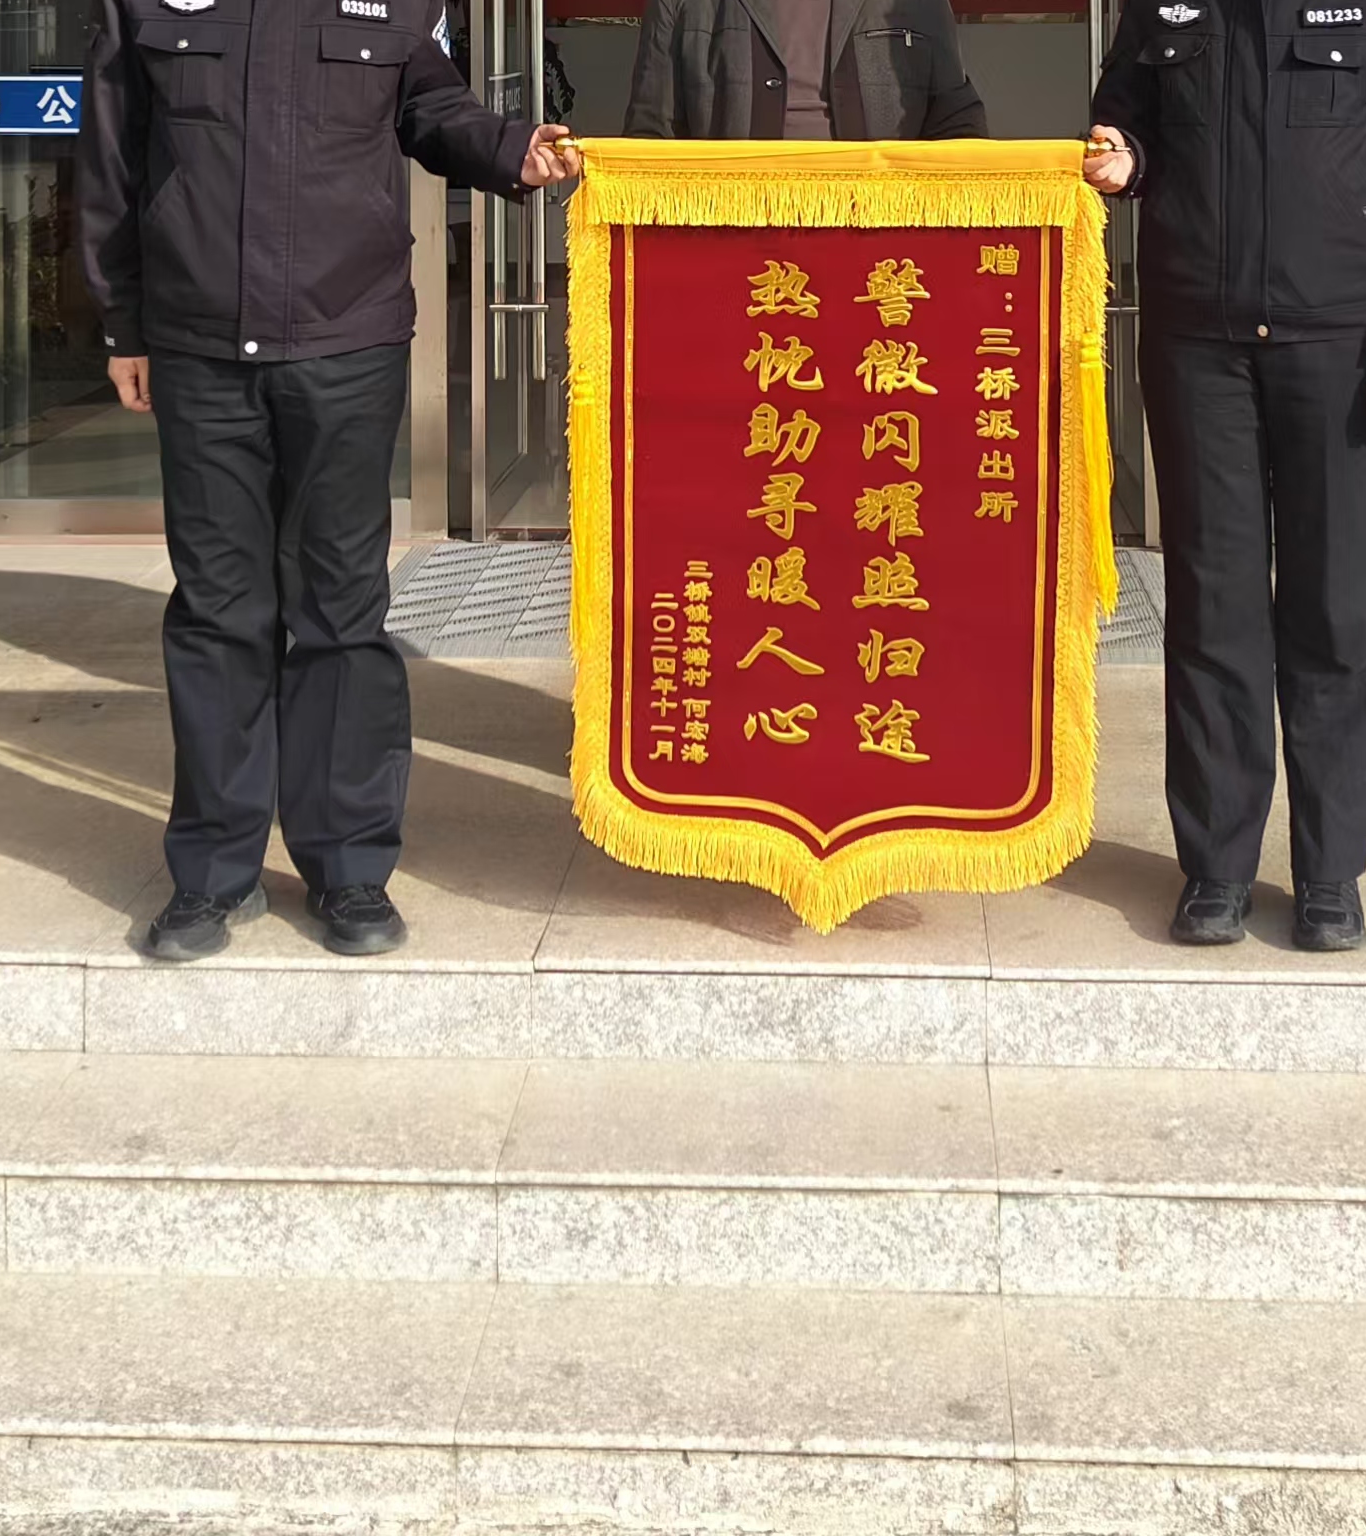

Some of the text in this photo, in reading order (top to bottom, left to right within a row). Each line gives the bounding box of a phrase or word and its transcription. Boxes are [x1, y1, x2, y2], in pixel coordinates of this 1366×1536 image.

[341, 0, 388, 18] 033101
[1306, 8, 1363, 23] 081233
[36, 85, 78, 125] 公
[736, 260, 825, 744] 热忱助寻暖人心
[853, 259, 938, 763] 警徽闪耀照归途
